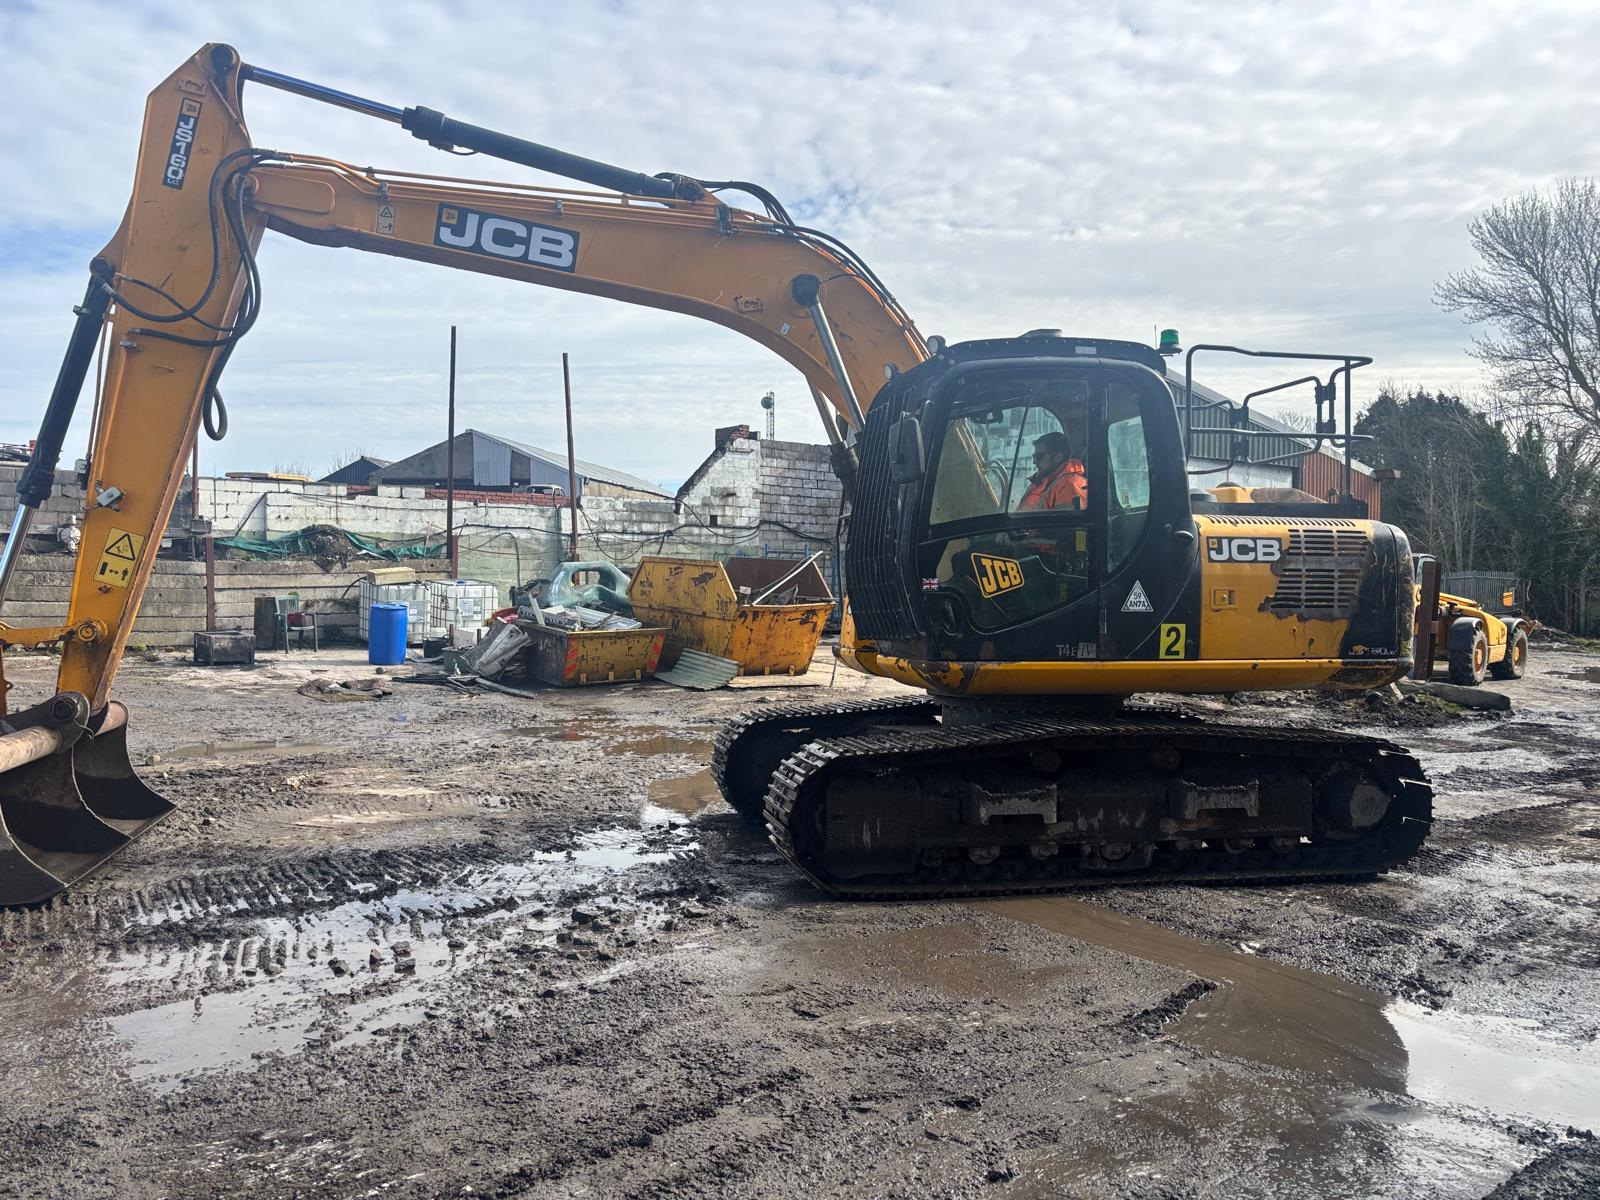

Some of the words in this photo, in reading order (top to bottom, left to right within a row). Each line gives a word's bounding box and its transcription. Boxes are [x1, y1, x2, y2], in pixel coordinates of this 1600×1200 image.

[166, 117, 195, 181] JS160
[439, 212, 575, 268] JCB
[1209, 538, 1281, 562] JCB
[981, 558, 1021, 593] JCB
[1133, 592, 1142, 600] 59
[1164, 626, 1182, 656] 2
